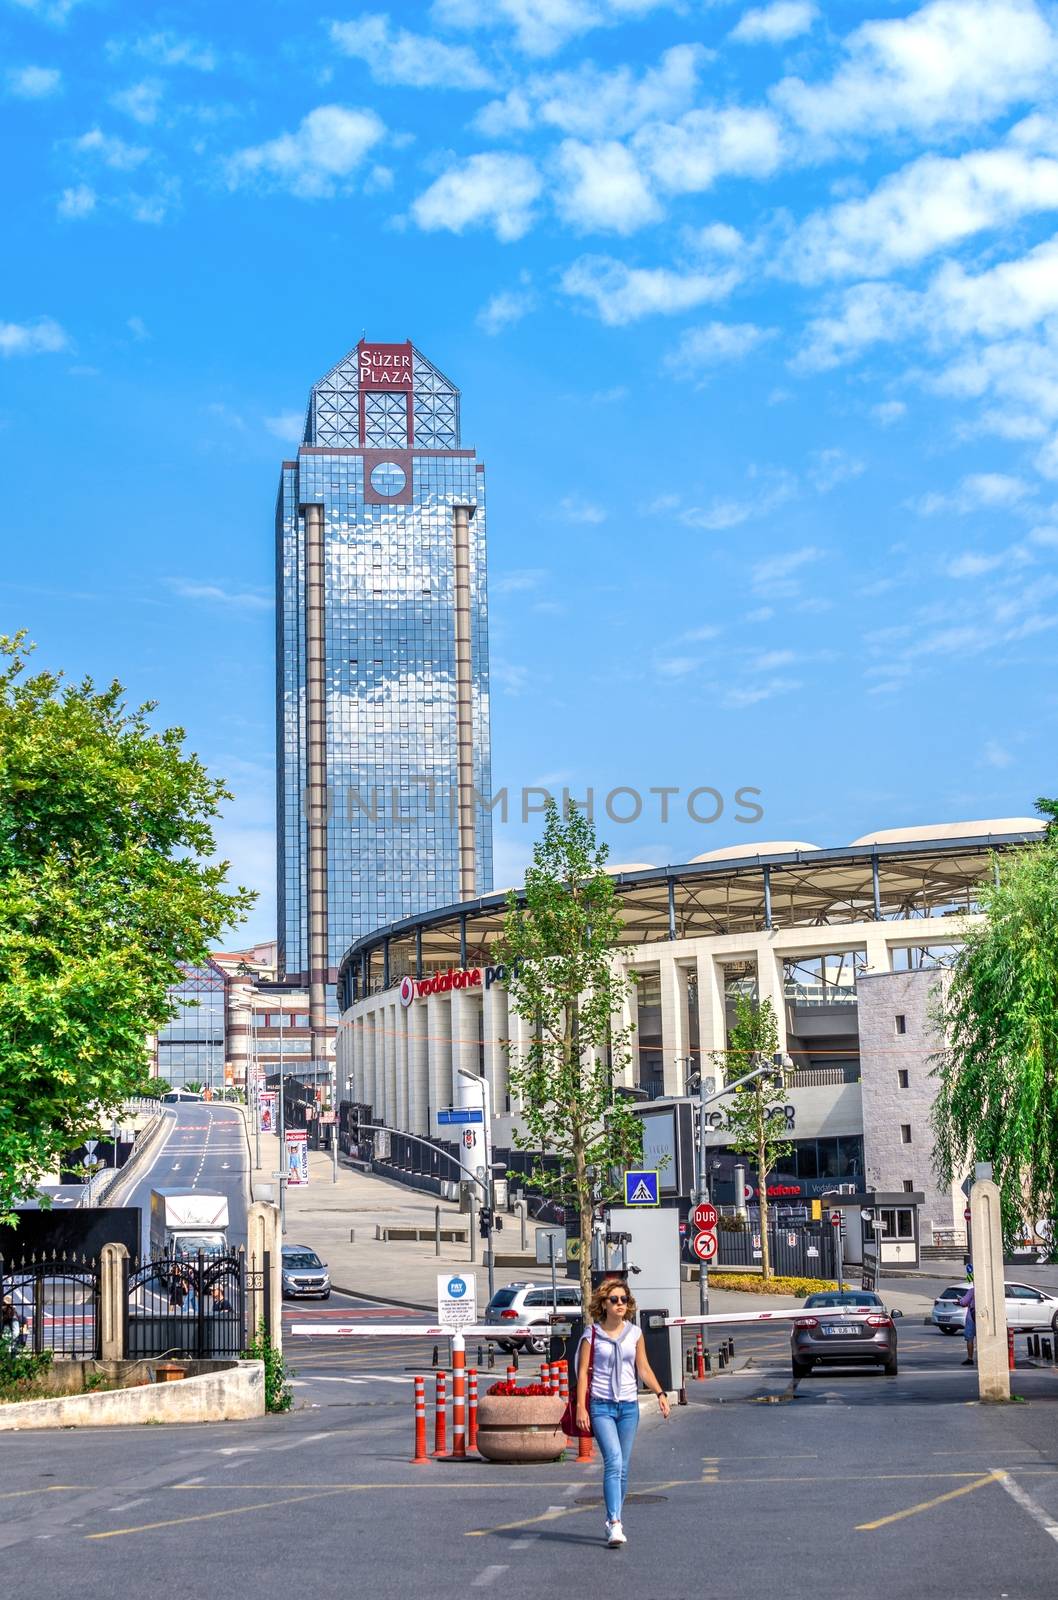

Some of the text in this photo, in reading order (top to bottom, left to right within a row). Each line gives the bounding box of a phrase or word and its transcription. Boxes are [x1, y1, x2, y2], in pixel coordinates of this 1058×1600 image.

[360, 351, 411, 367] SÜZER
[360, 367, 412, 383] PLAZA
[416, 967, 481, 998] vodafone
[696, 1211, 715, 1222] DUR
